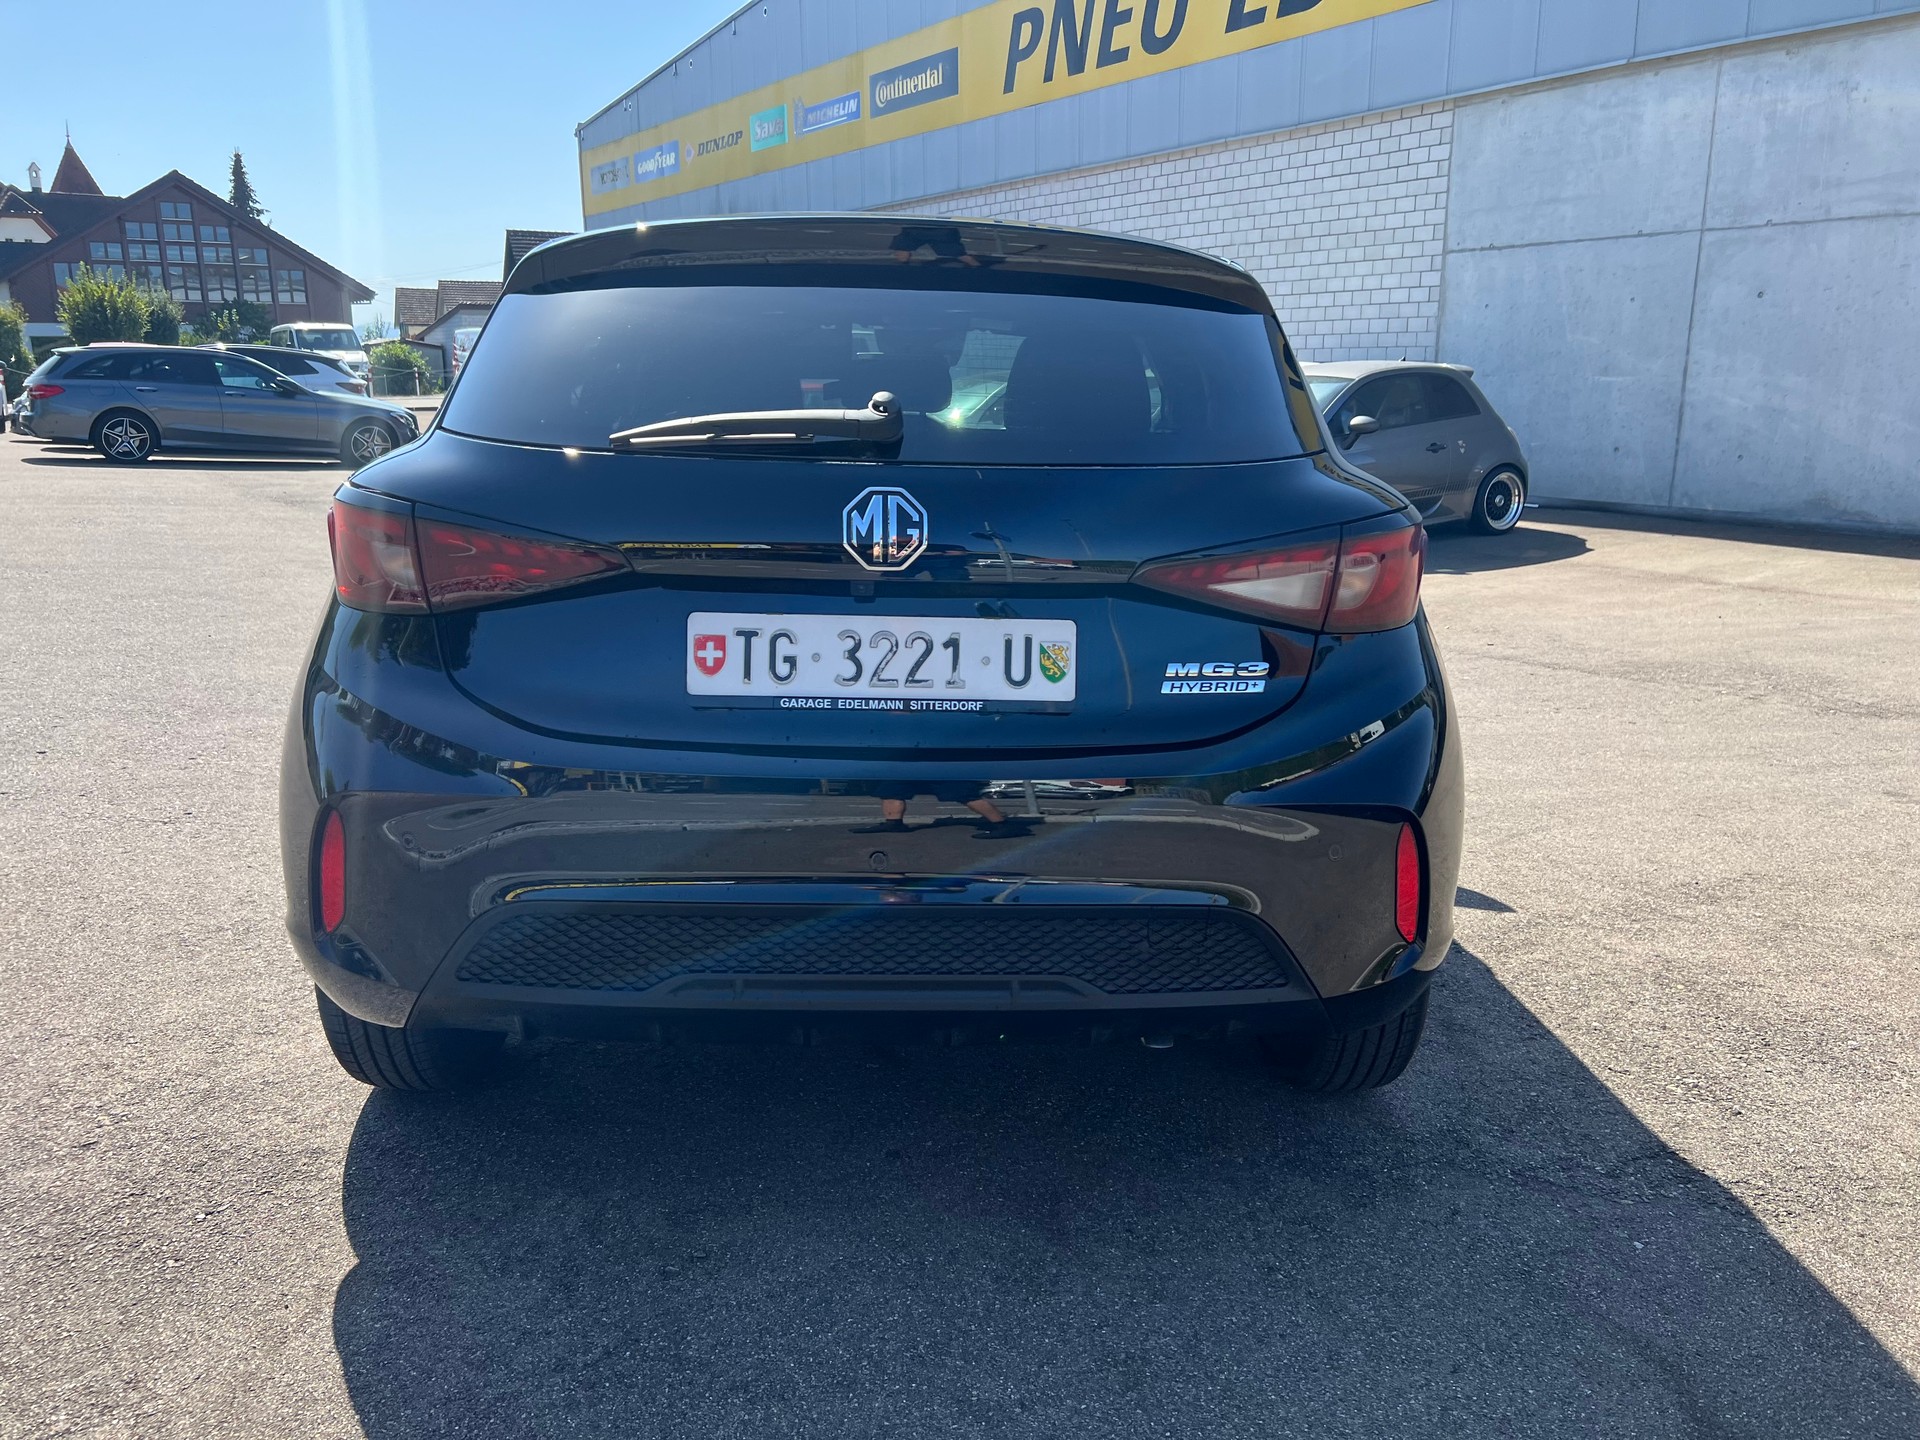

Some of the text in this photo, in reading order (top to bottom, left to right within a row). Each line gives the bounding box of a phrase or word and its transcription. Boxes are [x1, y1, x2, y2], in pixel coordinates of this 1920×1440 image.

[1003, 0, 1189, 95] PNEU
[875, 62, 944, 108] Continental
[806, 98, 858, 126] MICHELIN
[754, 116, 785, 142] Sava
[697, 130, 744, 157] DUNLOP
[849, 492, 922, 564] MG
[733, 627, 1033, 690] TG 3221 U
[1164, 661, 1270, 677] MG3
[780, 698, 984, 712] GARAGE EDELMANN SITTERDORF
